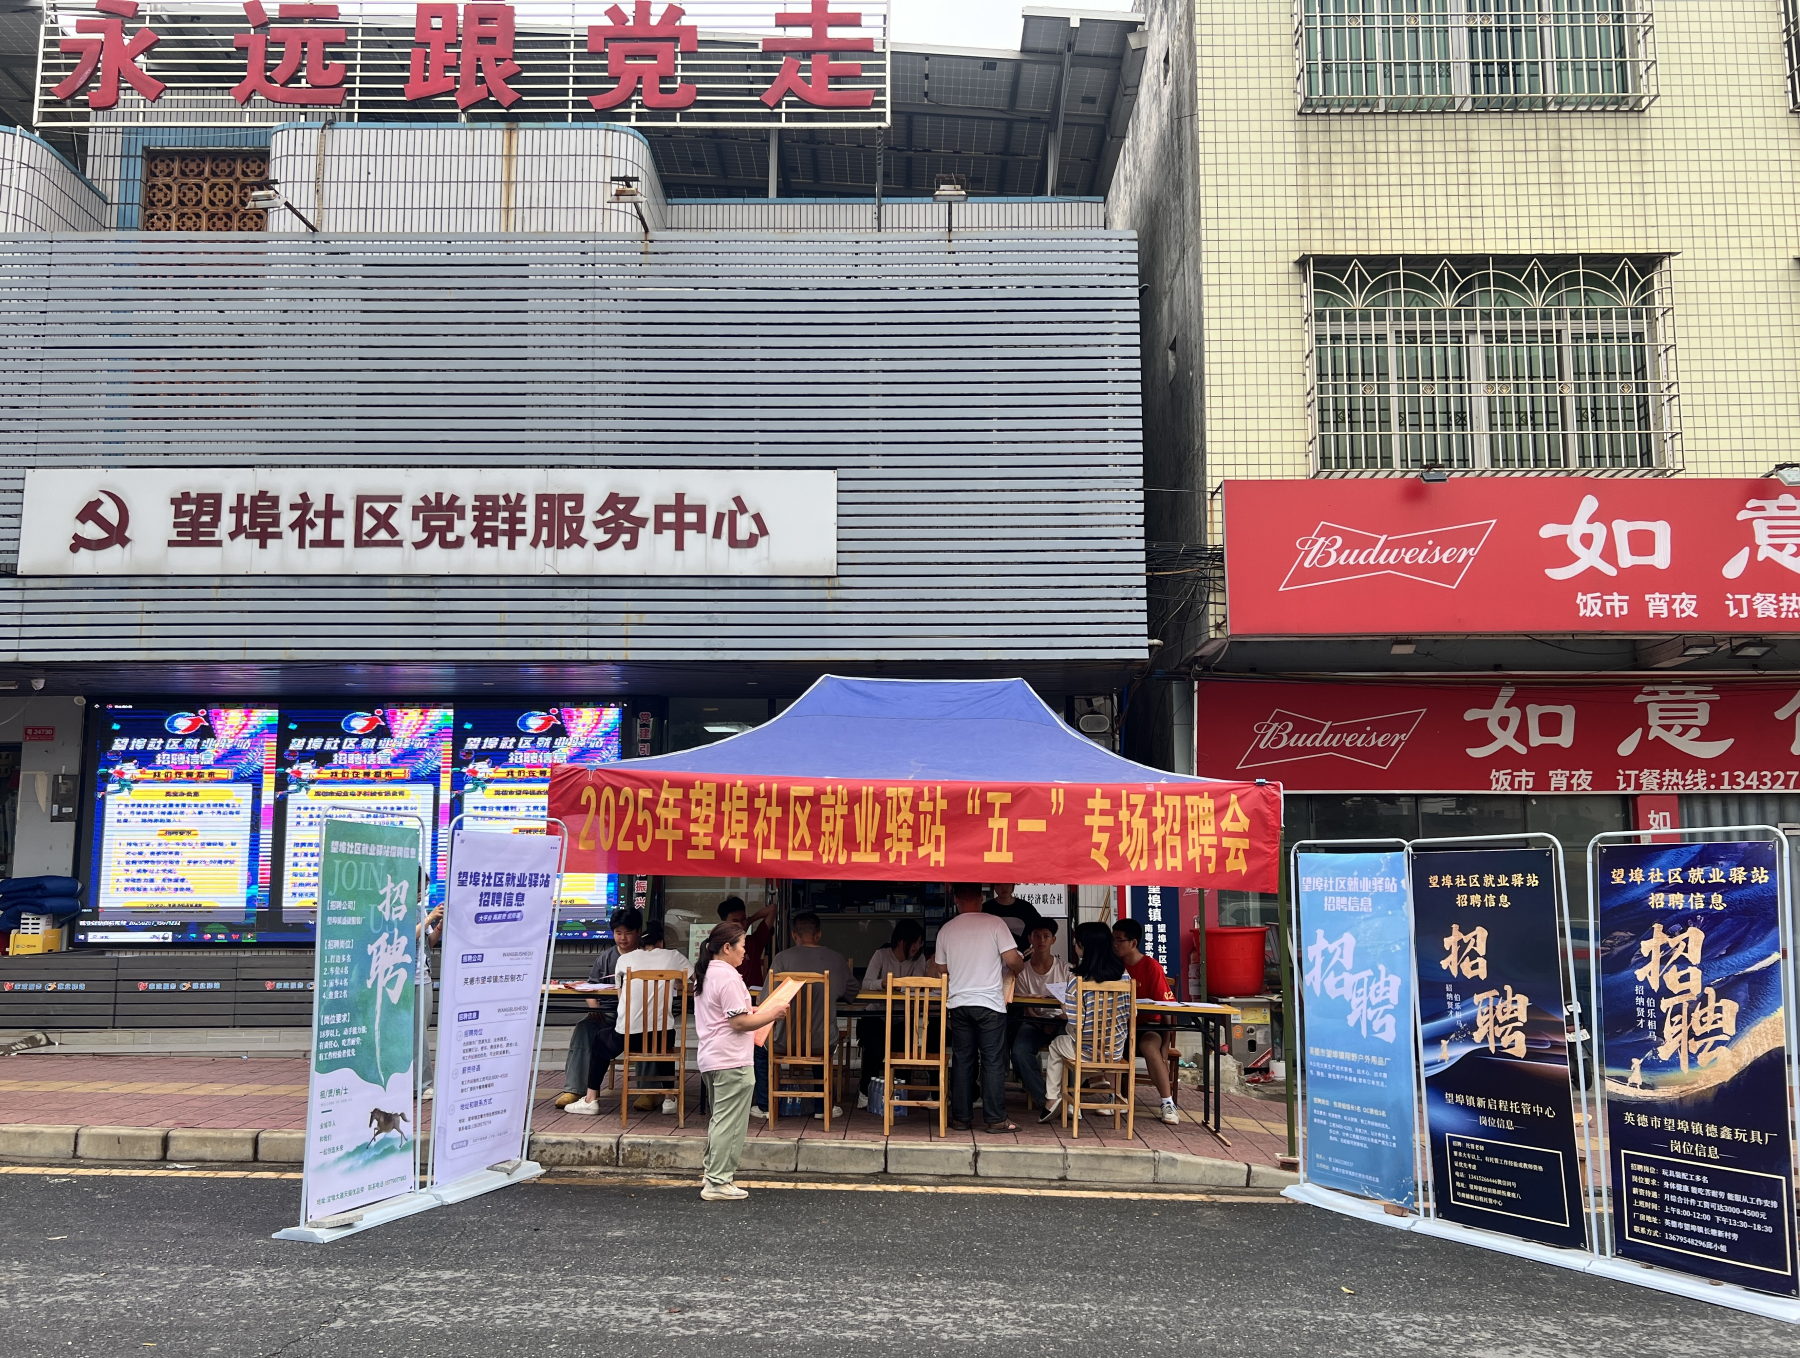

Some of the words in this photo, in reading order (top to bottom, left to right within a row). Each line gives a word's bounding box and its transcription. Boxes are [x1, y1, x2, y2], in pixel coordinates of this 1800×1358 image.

[50, 0, 877, 112] 永远跟党走
[168, 491, 769, 552] 望埠社区党群服务中心
[1296, 533, 1478, 568] Budweiser
[1576, 592, 1631, 619] 饭市
[1645, 592, 1699, 619] 宵夜
[1463, 683, 1800, 758] 如意
[112, 737, 250, 750] 望埠社区就业驿站
[288, 737, 429, 750] 望埠社区就业驿站
[463, 737, 604, 749] 望埠社区就业驿站
[1254, 720, 1407, 750] Budweiser
[155, 753, 215, 765] 招聘信息
[332, 752, 392, 765] 招聘信息
[507, 752, 568, 764] 招聘信息
[1490, 769, 1536, 791] 饭市
[1548, 769, 1594, 791] 宵夜
[1648, 810, 1671, 830] 如
[330, 841, 416, 858] 望埠社区就业驿站招聘信息
[328, 860, 385, 896] JOIN
[457, 871, 551, 888] 望埠社区就业驿站
[1302, 876, 1398, 893] 望埠社区就业驿站
[1428, 873, 1540, 888] 望埠社区就业驿站
[1610, 866, 1770, 885] 望埠社区就业驿站
[478, 892, 525, 907] 招聘信息
[1323, 896, 1373, 912] 招聘信息
[1456, 894, 1512, 908] 招聘信息
[1648, 892, 1728, 911] 招聘信息
[366, 873, 412, 1084] 招聘
[1305, 928, 1401, 1044] 招聘
[1439, 923, 1533, 1059] 招聘
[1634, 923, 1740, 1075] 招聘
[1635, 984, 1646, 1029] 招纳贤才
[1646, 997, 1658, 1042] 伯乐相马
[1445, 1092, 1556, 1118] 望埠镇新启程托管中心
[1479, 1115, 1515, 1130] 岗位信息
[1623, 1112, 1778, 1145] 英德市望埠镇德鑫玩具厂
[1670, 1140, 1720, 1160] 岗位信息
